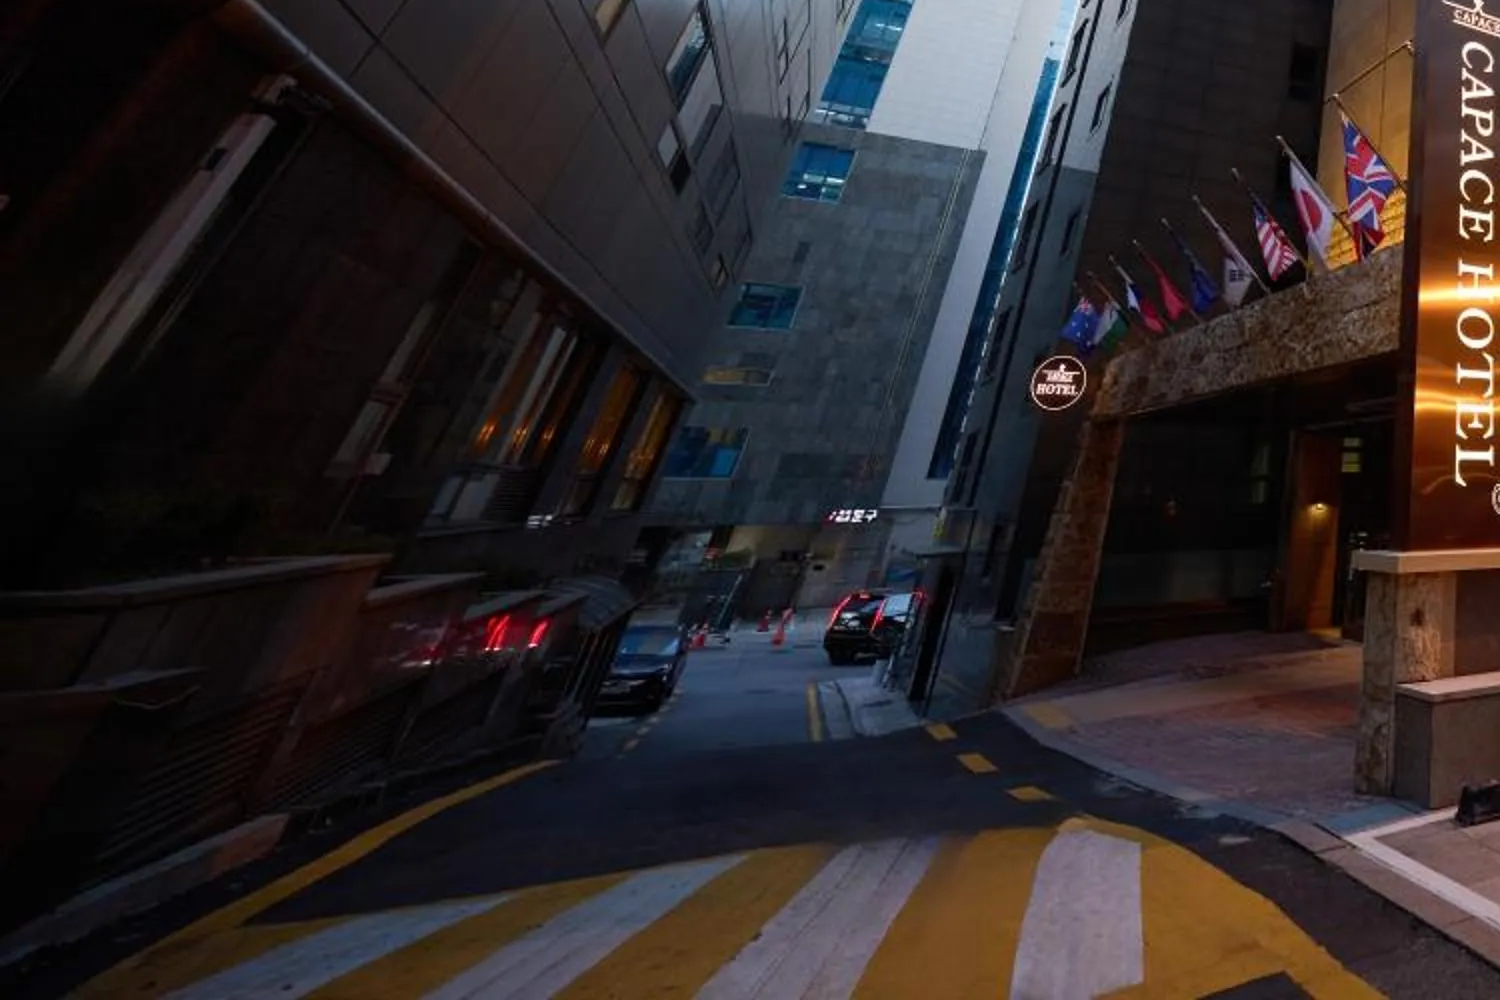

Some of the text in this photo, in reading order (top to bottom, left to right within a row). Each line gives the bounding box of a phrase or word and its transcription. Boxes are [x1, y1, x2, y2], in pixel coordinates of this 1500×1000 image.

[1455, 40, 1495, 487] CAPACE HOTEL
[1036, 383, 1079, 396] HOTEL
